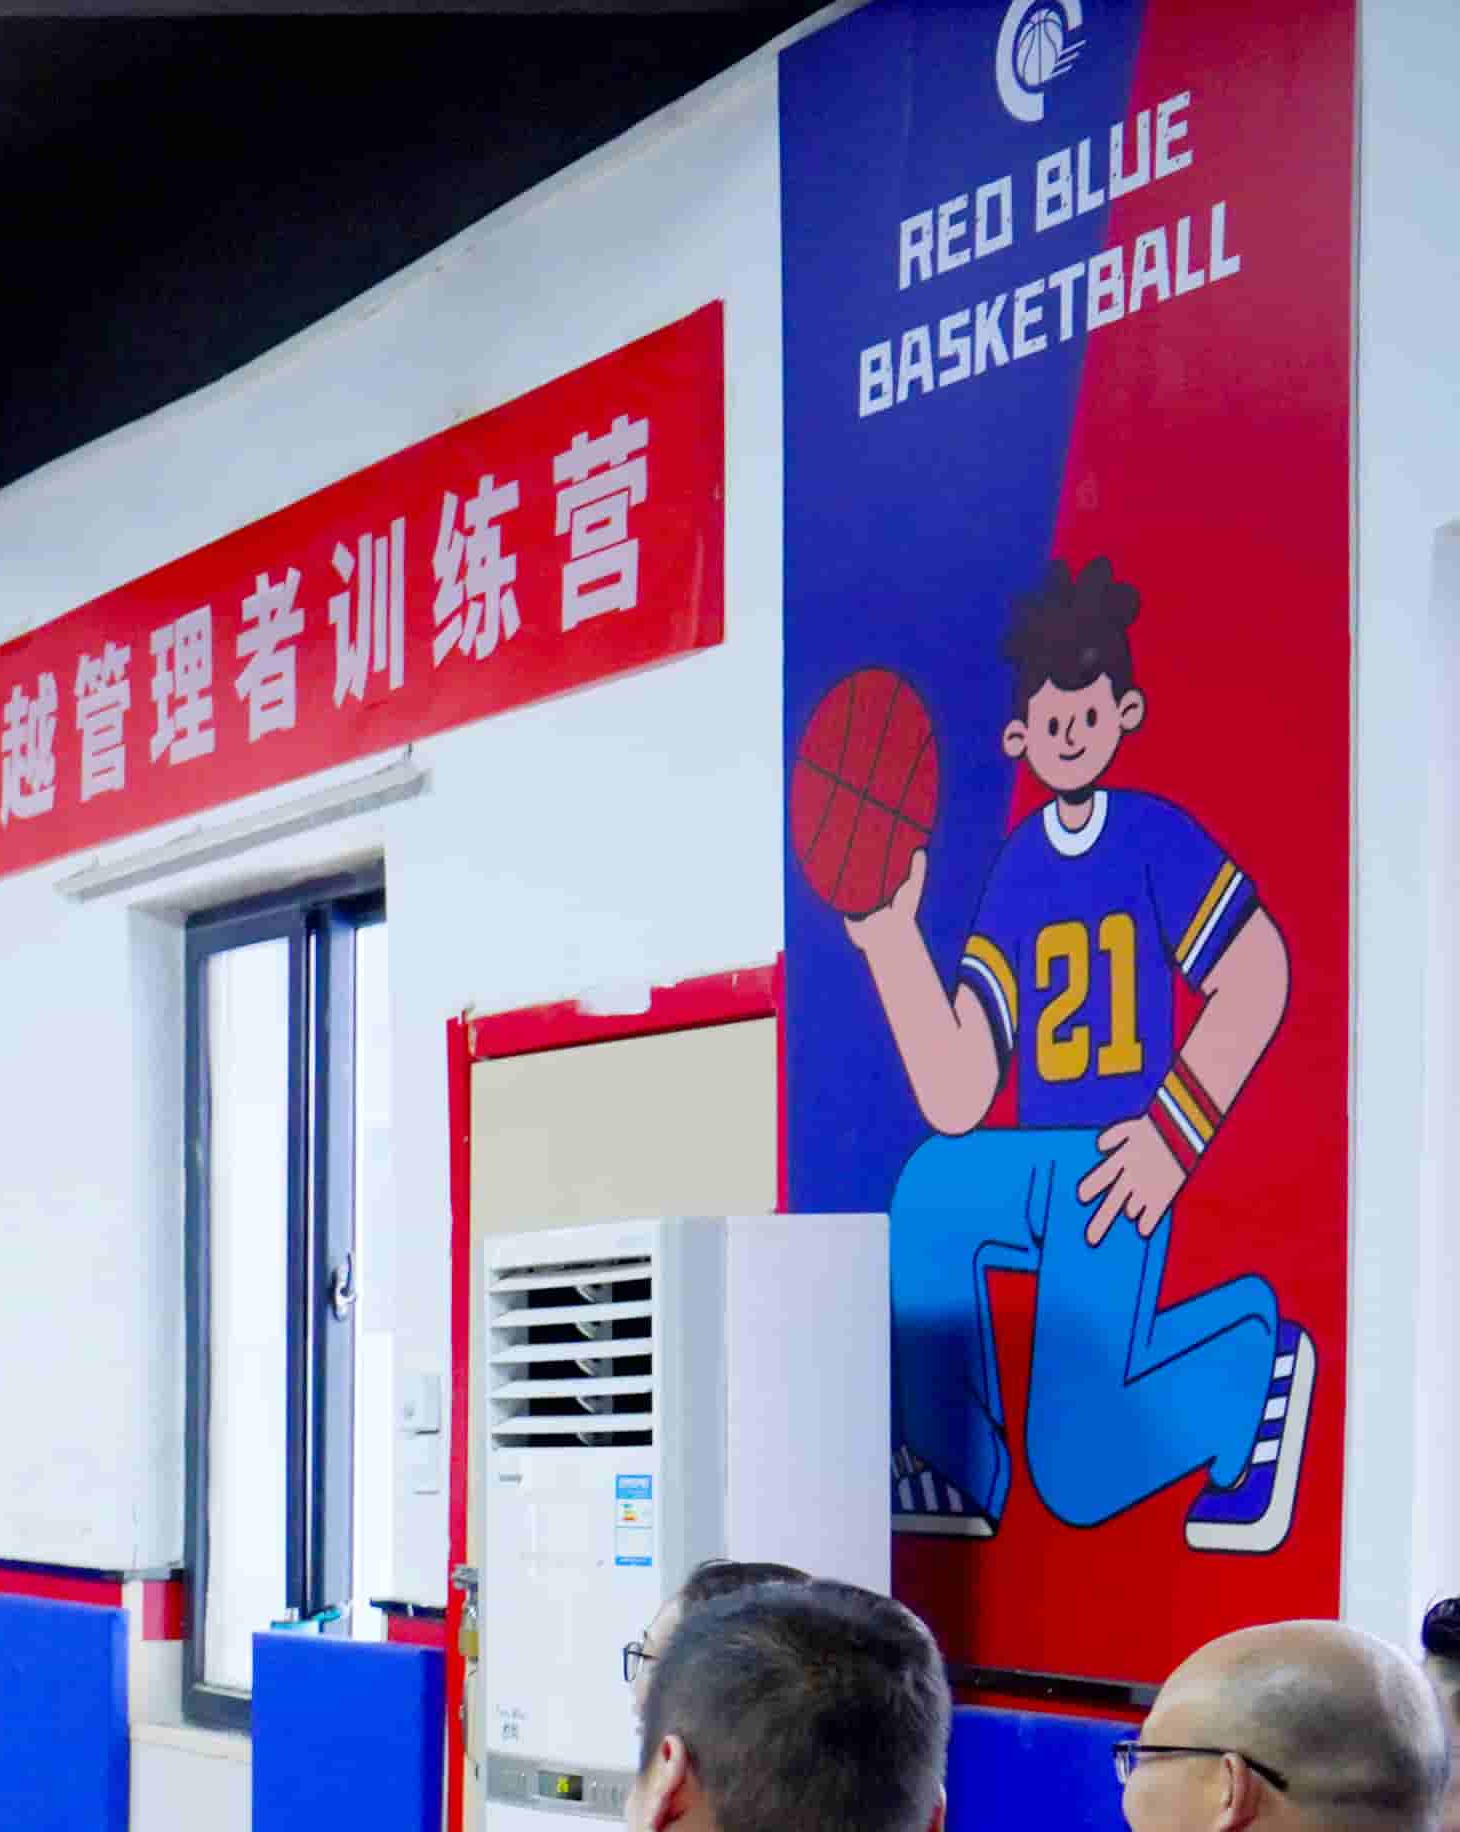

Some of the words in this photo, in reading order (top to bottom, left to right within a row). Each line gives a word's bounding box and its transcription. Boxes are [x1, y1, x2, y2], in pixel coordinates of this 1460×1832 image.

[899, 175, 1012, 291] RED
[1036, 90, 1194, 233] BLUE
[859, 201, 1241, 418] BASKETBALL
[1034, 912, 1144, 1082] 21
